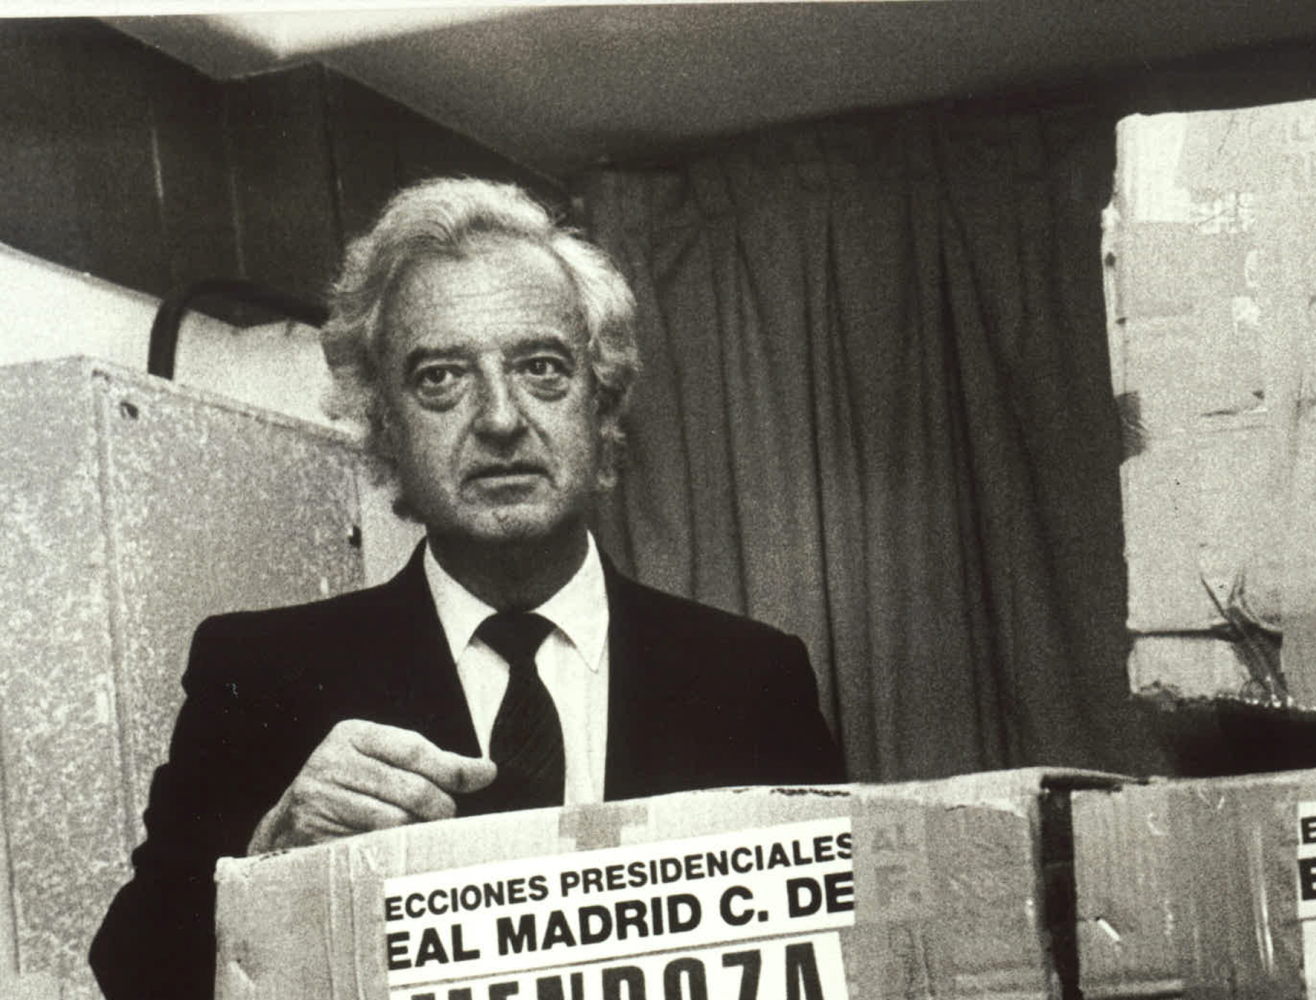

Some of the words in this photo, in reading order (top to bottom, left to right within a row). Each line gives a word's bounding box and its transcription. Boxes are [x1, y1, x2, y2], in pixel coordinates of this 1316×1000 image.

[385, 875, 549, 922] ECCIONES
[560, 832, 854, 899] PRESIDENCIALES
[386, 923, 481, 971] EAL
[496, 893, 702, 957] MADRID
[718, 885, 770, 928] C.
[786, 871, 855, 919] DE
